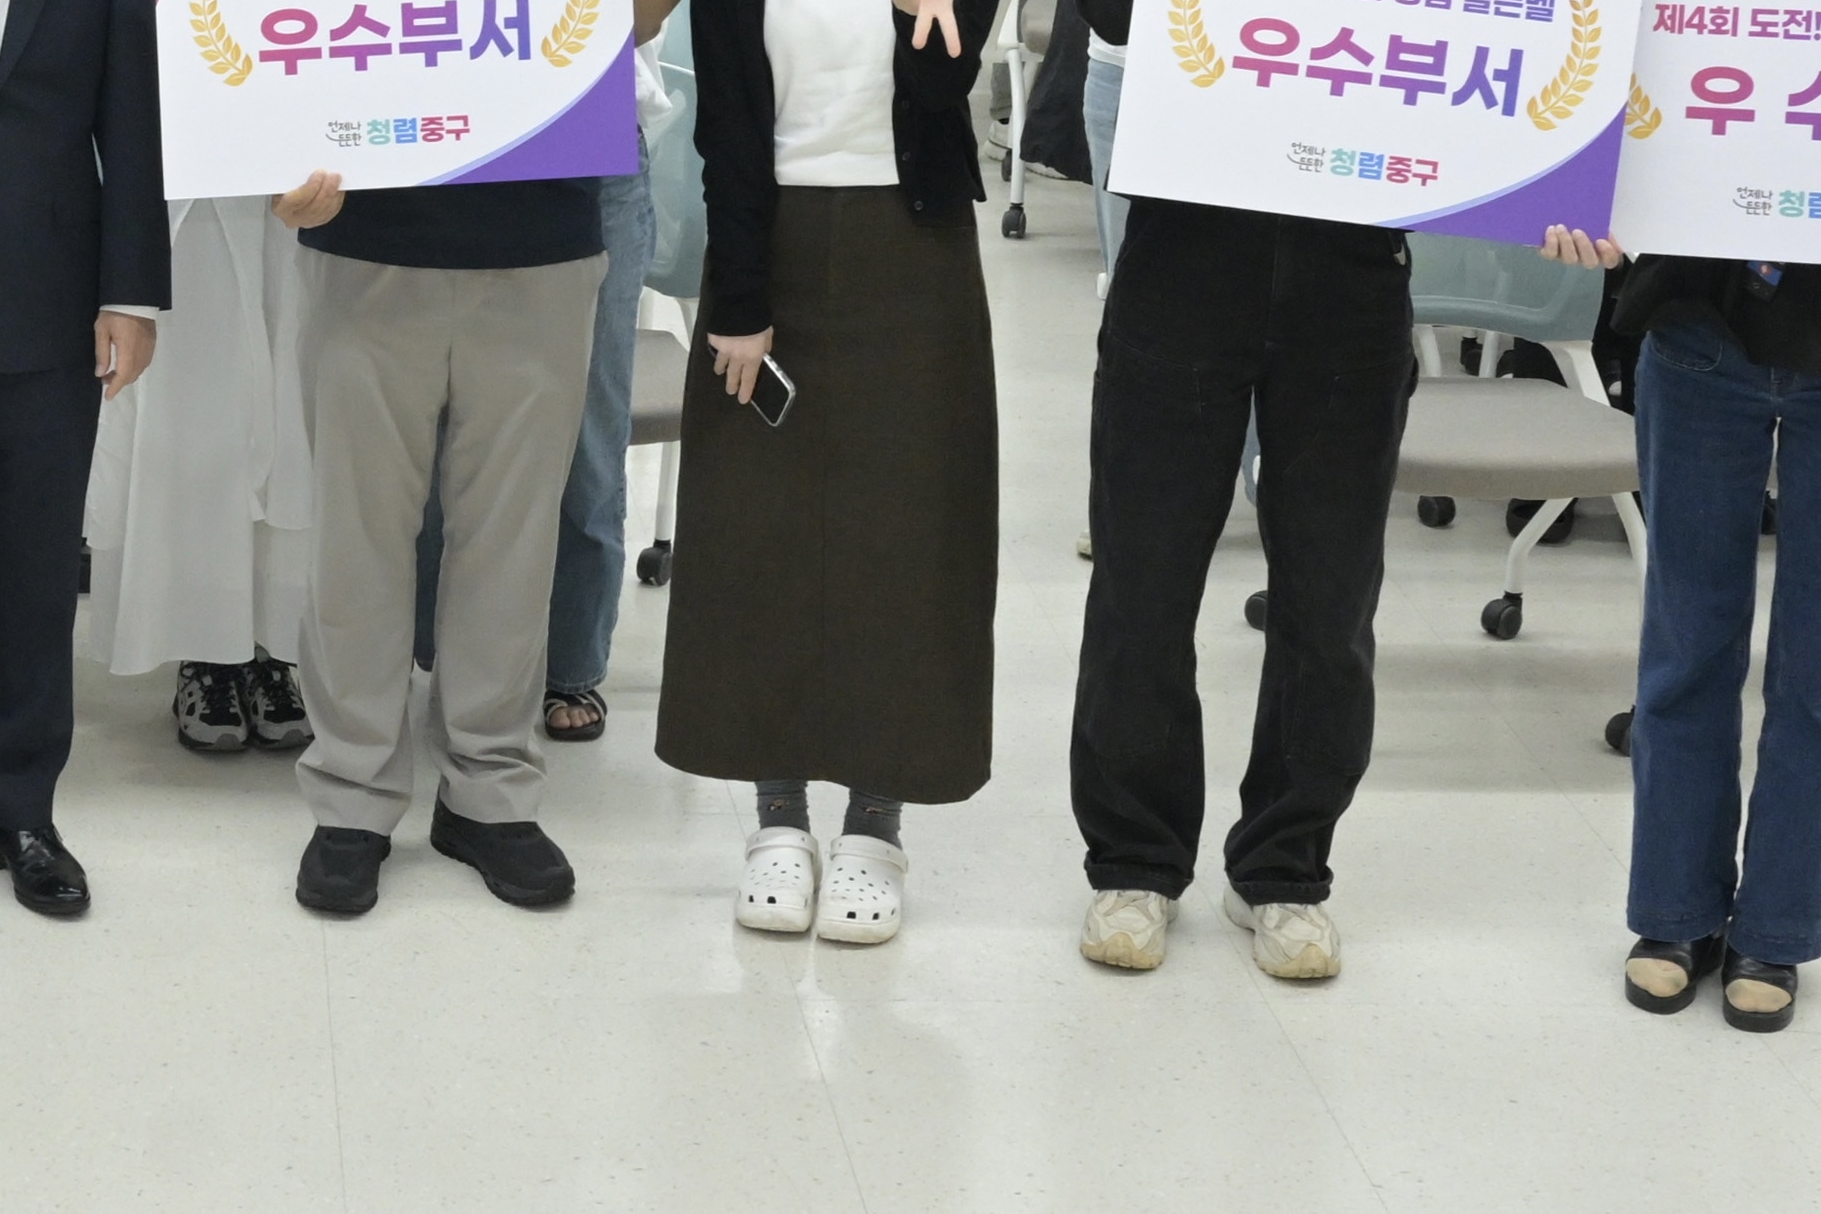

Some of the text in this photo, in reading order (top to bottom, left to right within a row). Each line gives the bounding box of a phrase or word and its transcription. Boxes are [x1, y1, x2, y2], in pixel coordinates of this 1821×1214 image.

[1653, 4, 1739, 37] 제4회
[1232, 17, 1524, 117] 우수부서
[328, 120, 361, 132] 언제나
[367, 115, 470, 145] 청렴중구
[1291, 142, 1326, 156] 언제나
[1330, 148, 1439, 186] 청렴중구
[1736, 186, 1773, 200] 언제나
